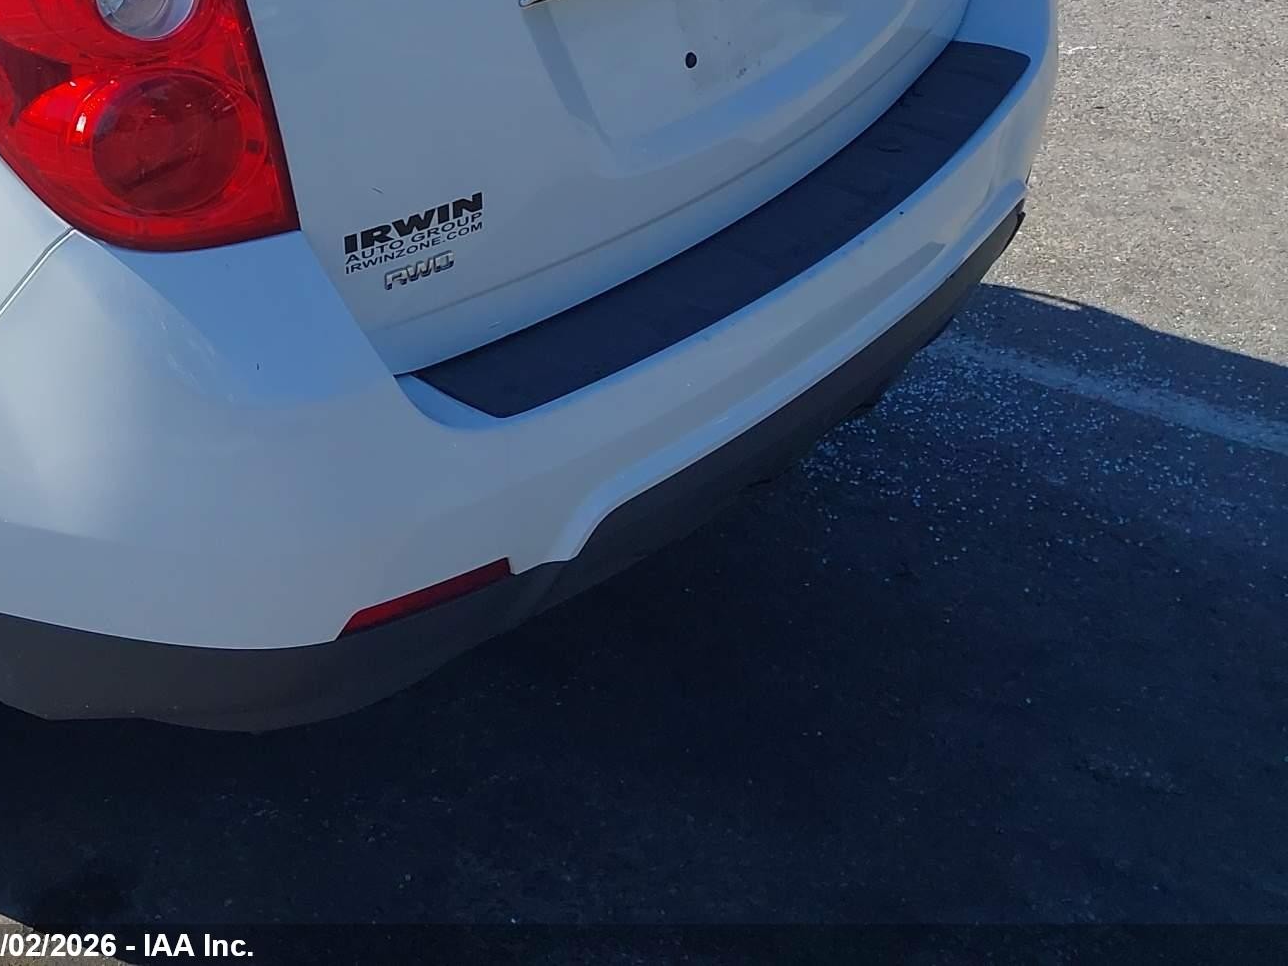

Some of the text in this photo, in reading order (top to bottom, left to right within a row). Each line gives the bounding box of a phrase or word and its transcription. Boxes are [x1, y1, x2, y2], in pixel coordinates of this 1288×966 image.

[343, 191, 483, 254] IRWIN
[345, 212, 482, 265] AUTO GROUP
[346, 221, 482, 274] IRWINZONE.COM
